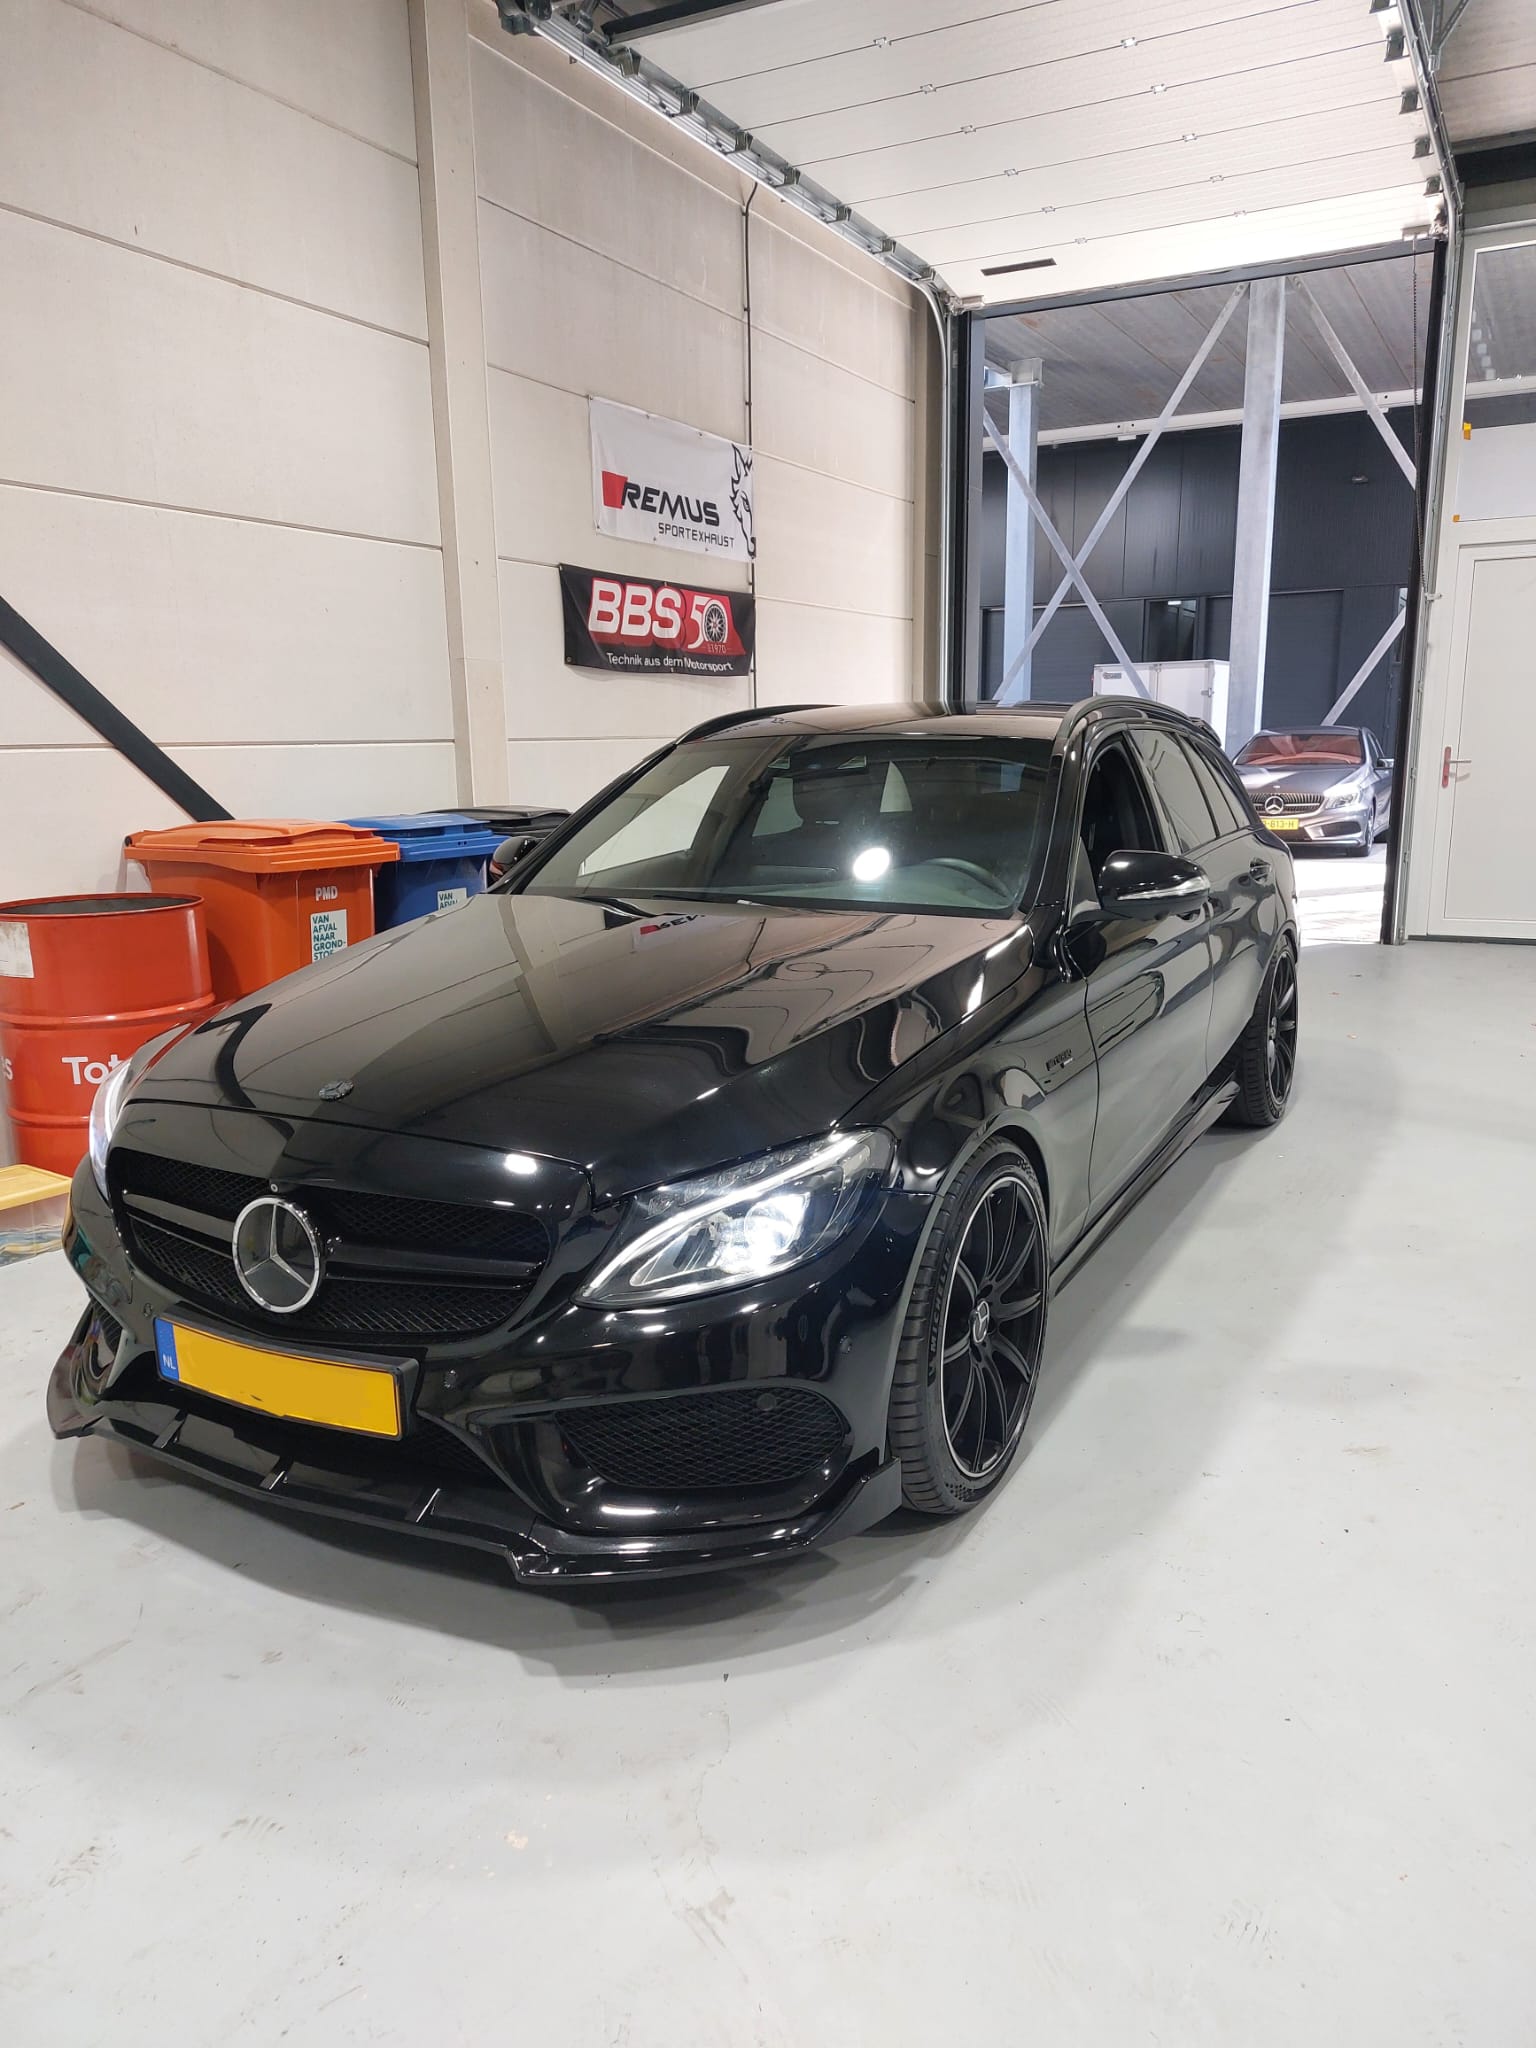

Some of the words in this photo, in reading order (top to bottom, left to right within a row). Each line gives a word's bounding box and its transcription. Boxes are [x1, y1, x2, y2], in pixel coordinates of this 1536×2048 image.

[622, 481, 720, 527] REMUS
[658, 522, 735, 548] SPORTEXHAUST
[588, 579, 682, 639] BBS
[606, 652, 642, 666] Technik
[644, 657, 661, 667] aus
[663, 655, 683, 667] dem
[683, 657, 733, 673] Motorsport
[315, 885, 338, 901] PMD
[438, 892, 453, 901] VAN
[312, 914, 330, 924] VAN
[312, 922, 337, 934] AFVAL
[313, 931, 336, 943] NAAR
[313, 939, 346, 952] GROND-
[162, 1353, 177, 1370] NL
